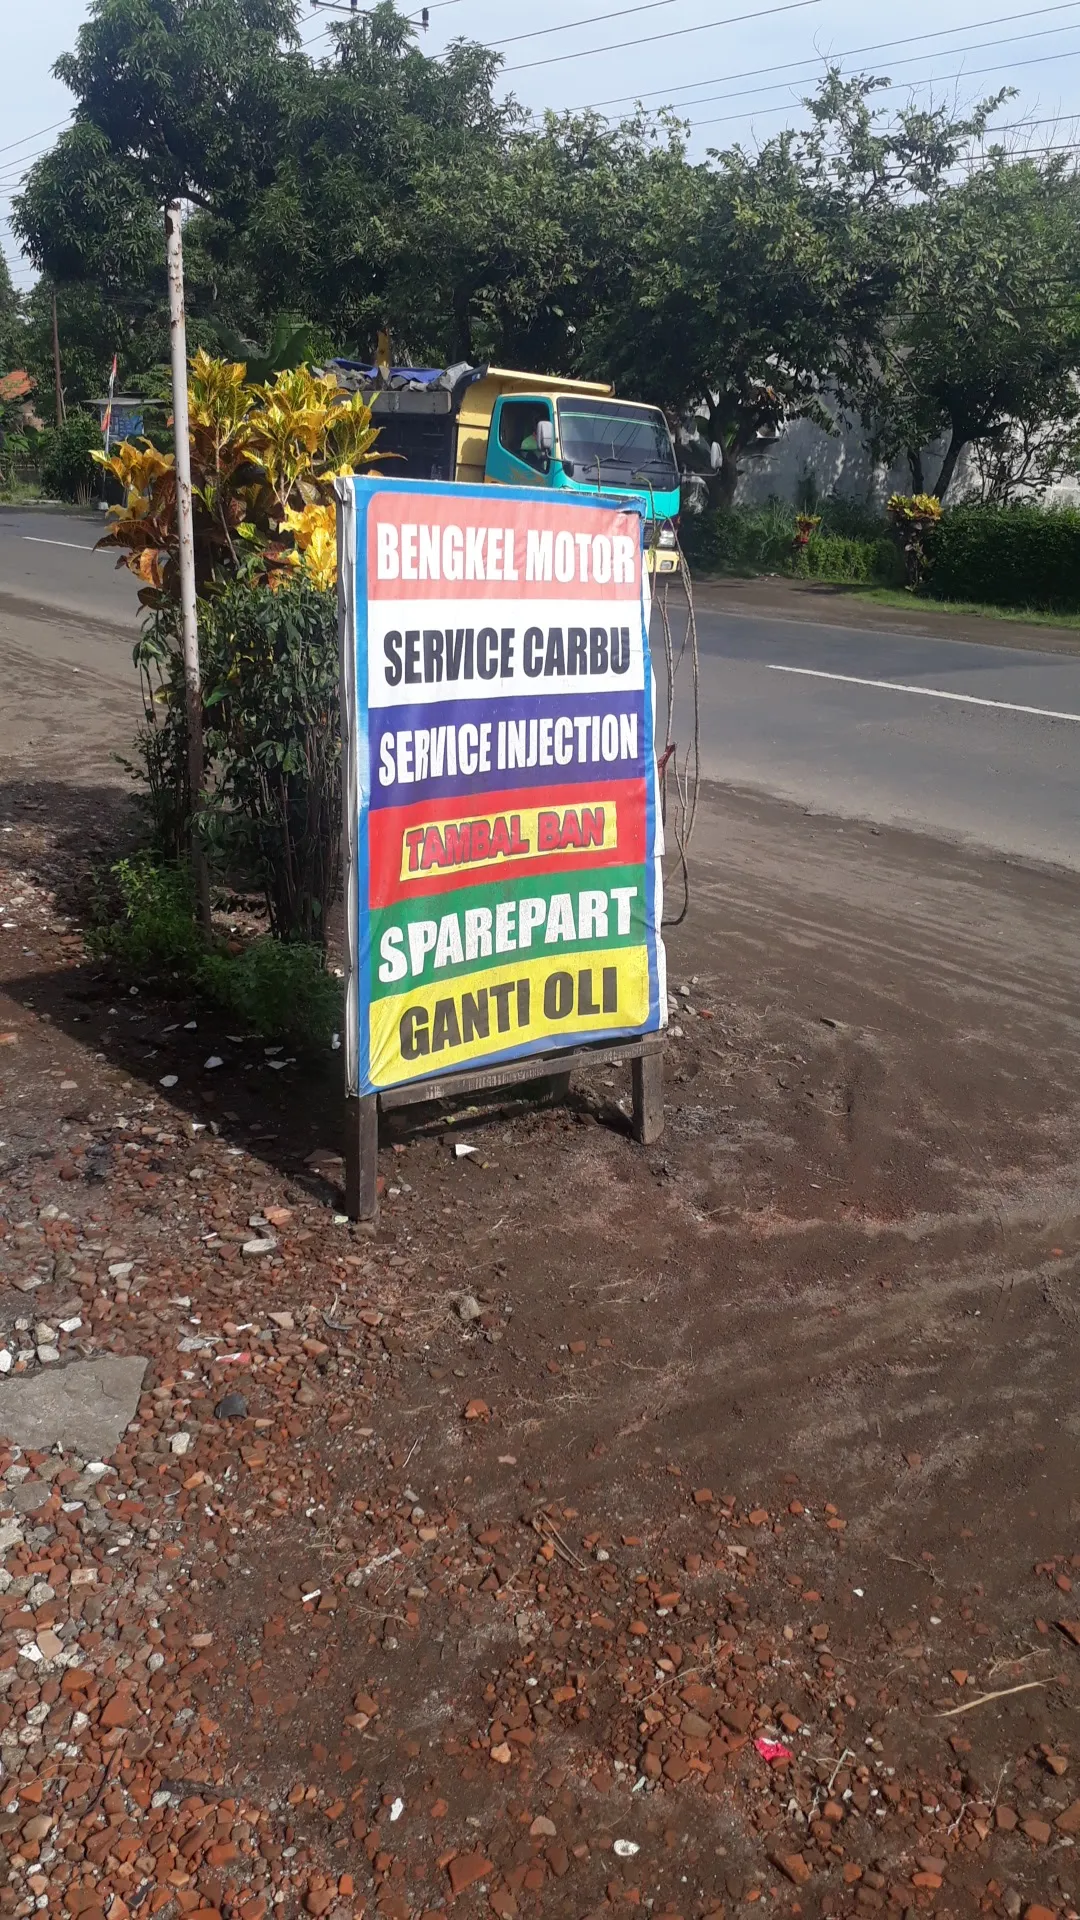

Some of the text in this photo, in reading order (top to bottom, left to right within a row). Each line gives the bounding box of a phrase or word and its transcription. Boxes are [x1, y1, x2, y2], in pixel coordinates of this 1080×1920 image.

[376, 522, 635, 583] BENGKEL MOTOR
[383, 626, 631, 686] SERVICE CARBU
[378, 713, 638, 786] SERVICE INJECTION
[405, 806, 606, 872] TAMBAL BAN
[377, 886, 638, 983] SPAREPART
[399, 966, 618, 1061] GANTI OLI
